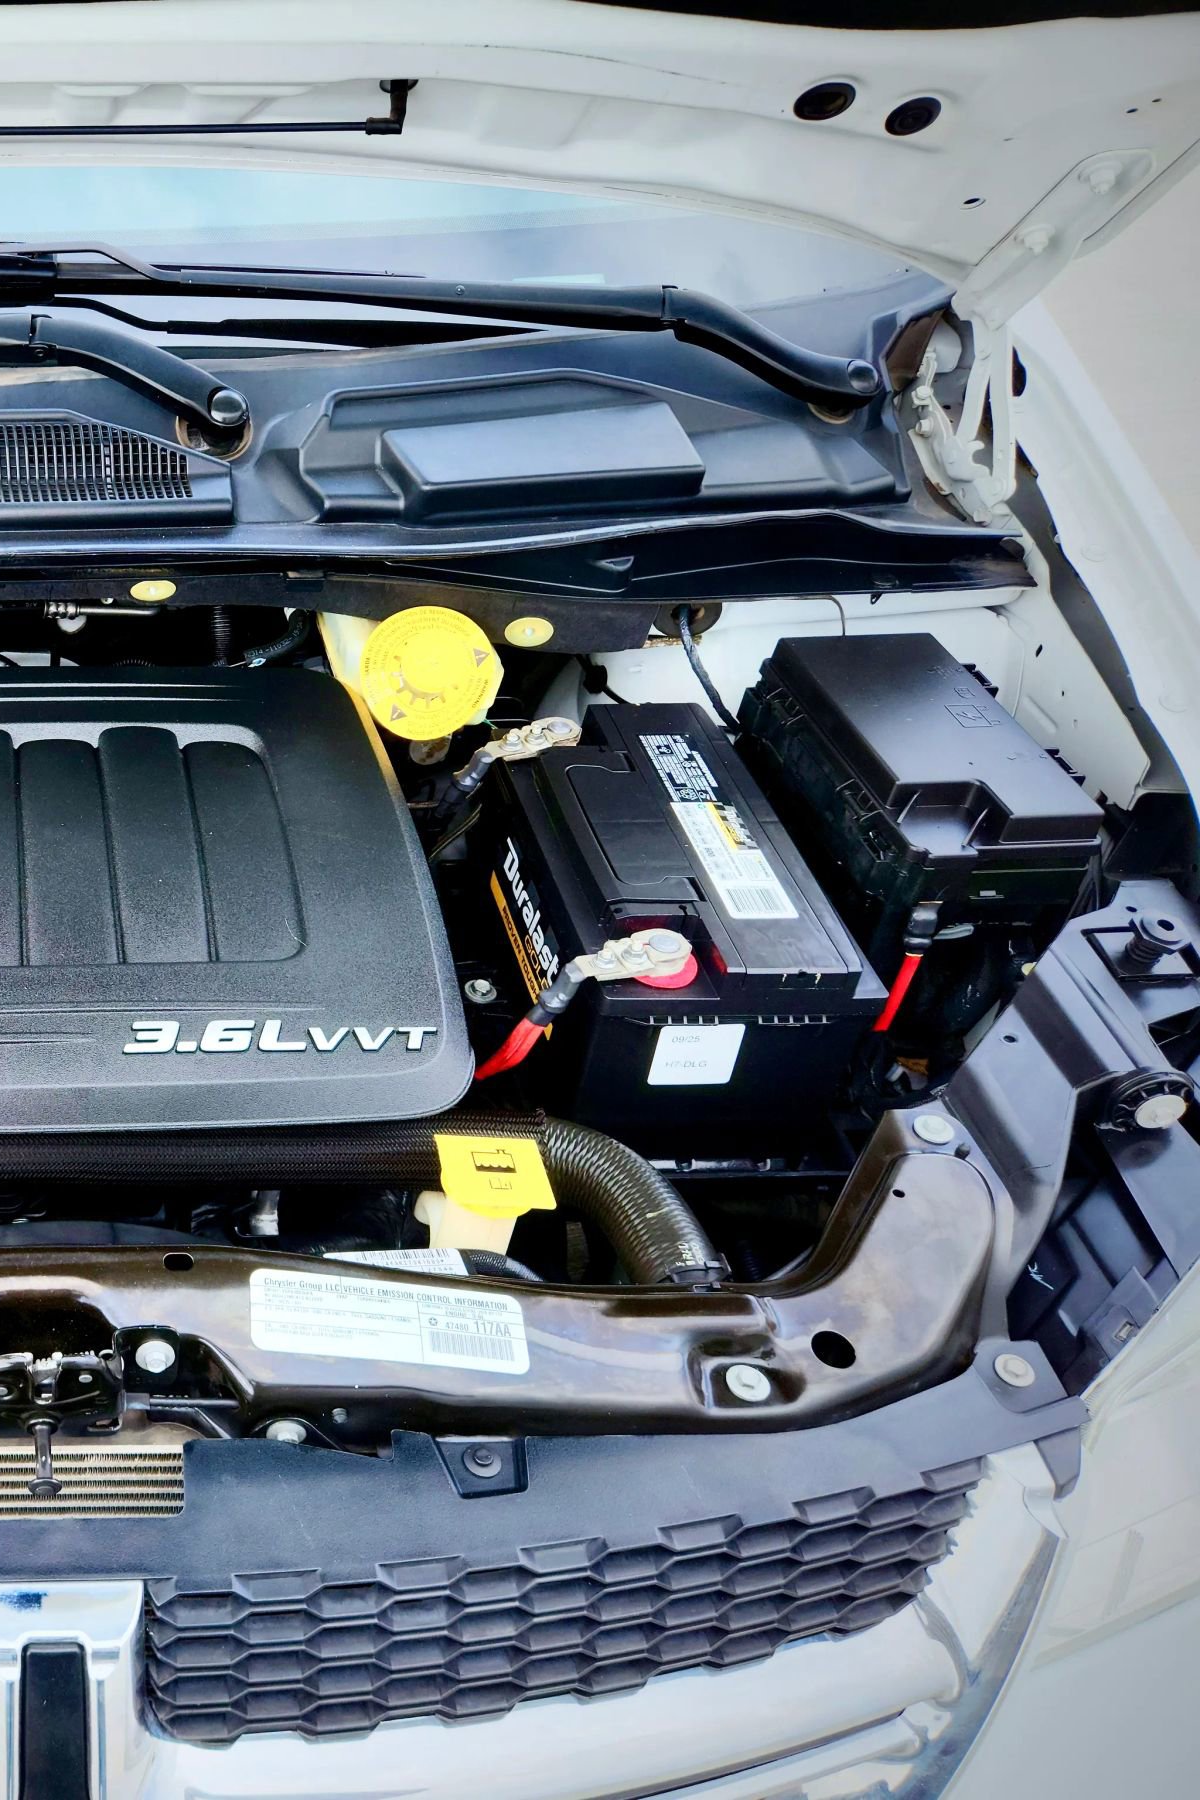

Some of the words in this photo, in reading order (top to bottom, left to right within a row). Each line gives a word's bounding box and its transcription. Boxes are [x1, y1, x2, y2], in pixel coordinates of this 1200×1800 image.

[472, 678, 489, 709] WARNING
[503, 836, 559, 987] Duralast
[502, 904, 522, 954] PROVEN
[308, 1026, 438, 1052] VVT
[264, 1277, 296, 1288] Chrysler
[299, 1280, 323, 1292] Group
[325, 1282, 340, 1293] LLC
[343, 1285, 375, 1296] VEHICLE
[377, 1288, 414, 1300] EMISSION
[416, 1293, 452, 1304] CONTROL
[454, 1297, 508, 1311] INFORMATION
[474, 1321, 512, 1337] 117AA
